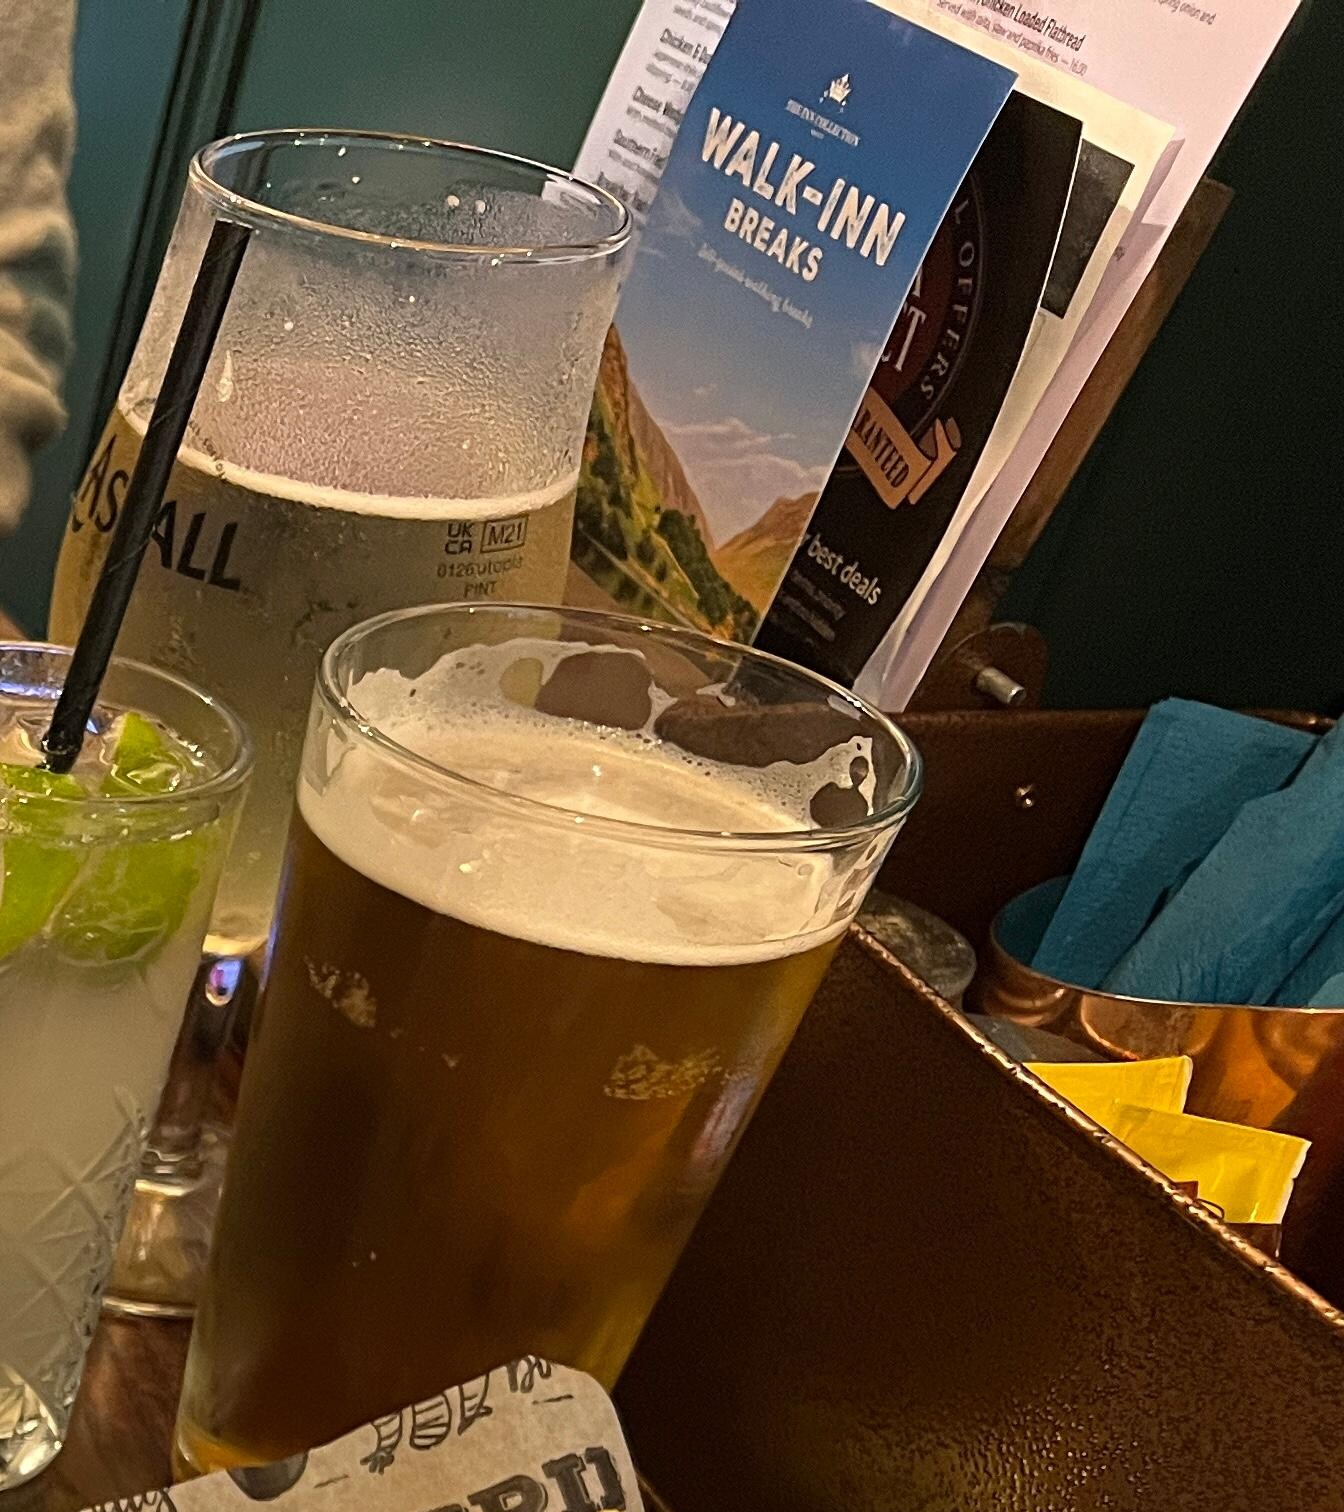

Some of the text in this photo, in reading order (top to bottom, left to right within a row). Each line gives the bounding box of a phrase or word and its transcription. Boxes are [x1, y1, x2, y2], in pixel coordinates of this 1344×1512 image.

[1013, 3, 1049, 33] Loaded
[1044, 18, 1087, 51] Flatbread
[702, 106, 906, 267] WALK-INN
[724, 198, 823, 282] BREAKS
[919, 241, 975, 401] OFFERS
[74, 433, 241, 592] ASALL
[447, 521, 523, 546] UK M21
[463, 580, 498, 599] PINT
[807, 533, 882, 605] best deals
